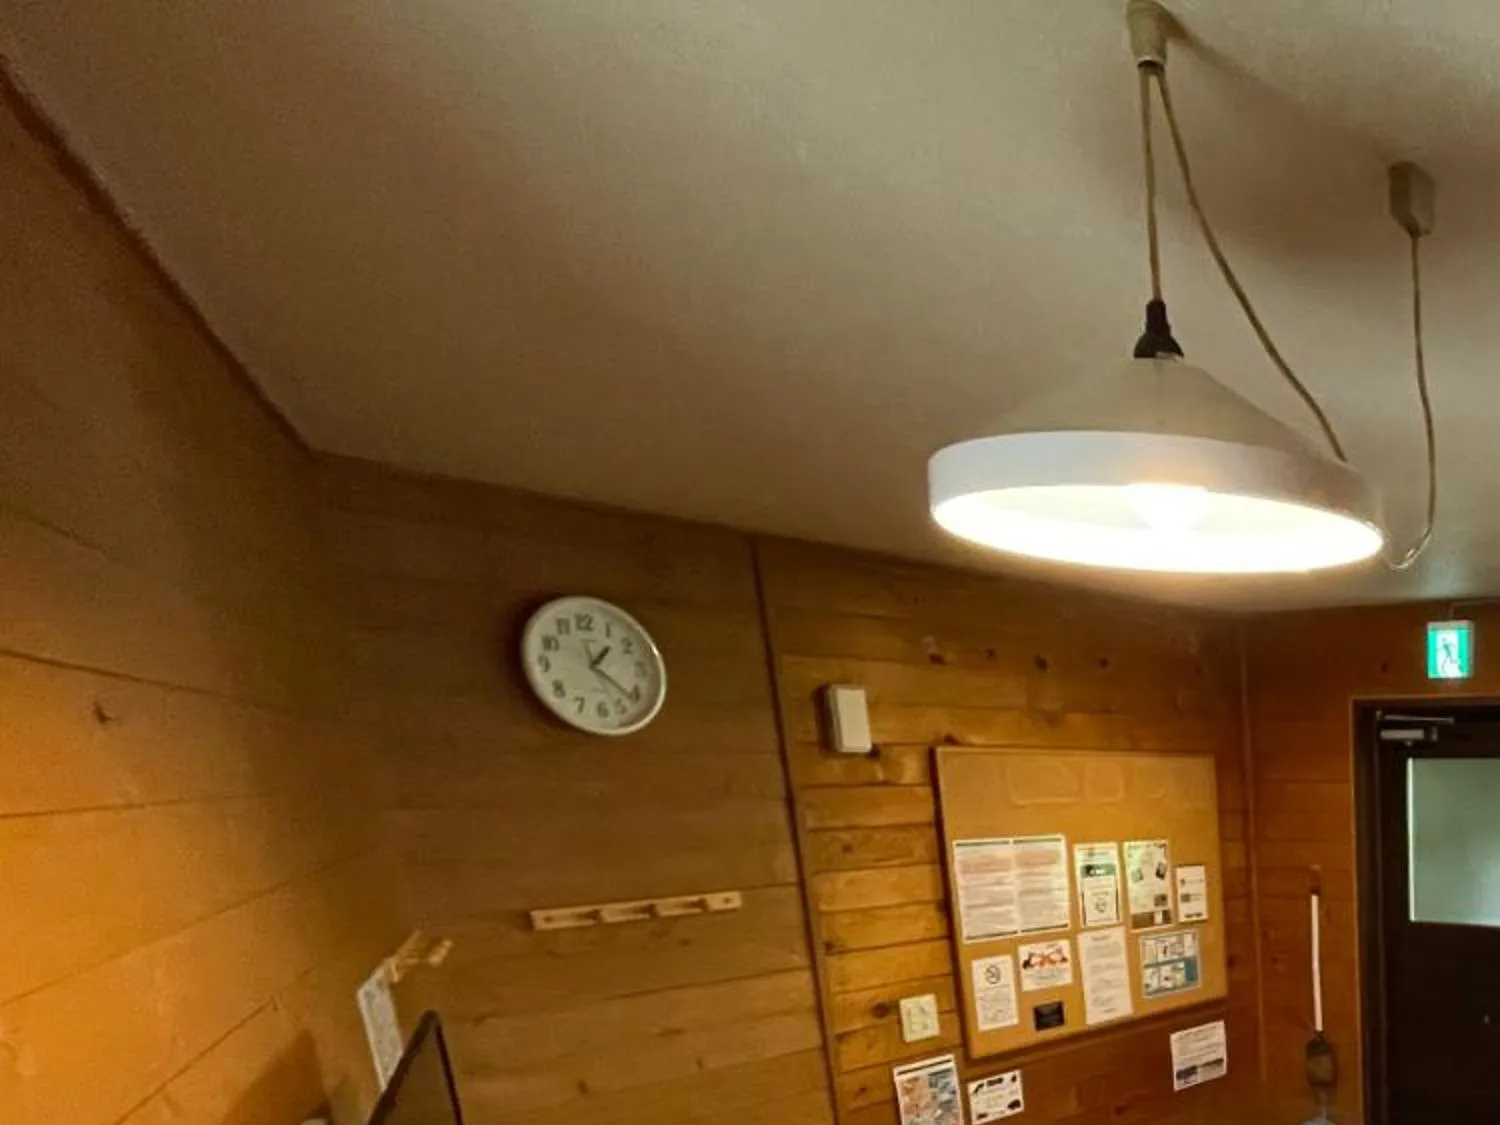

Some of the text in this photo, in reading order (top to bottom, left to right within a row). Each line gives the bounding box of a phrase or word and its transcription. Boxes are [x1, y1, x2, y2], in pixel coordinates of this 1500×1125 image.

[575, 613, 593, 631] 12
[604, 621, 611, 638] 1
[574, 696, 586, 714] 7
